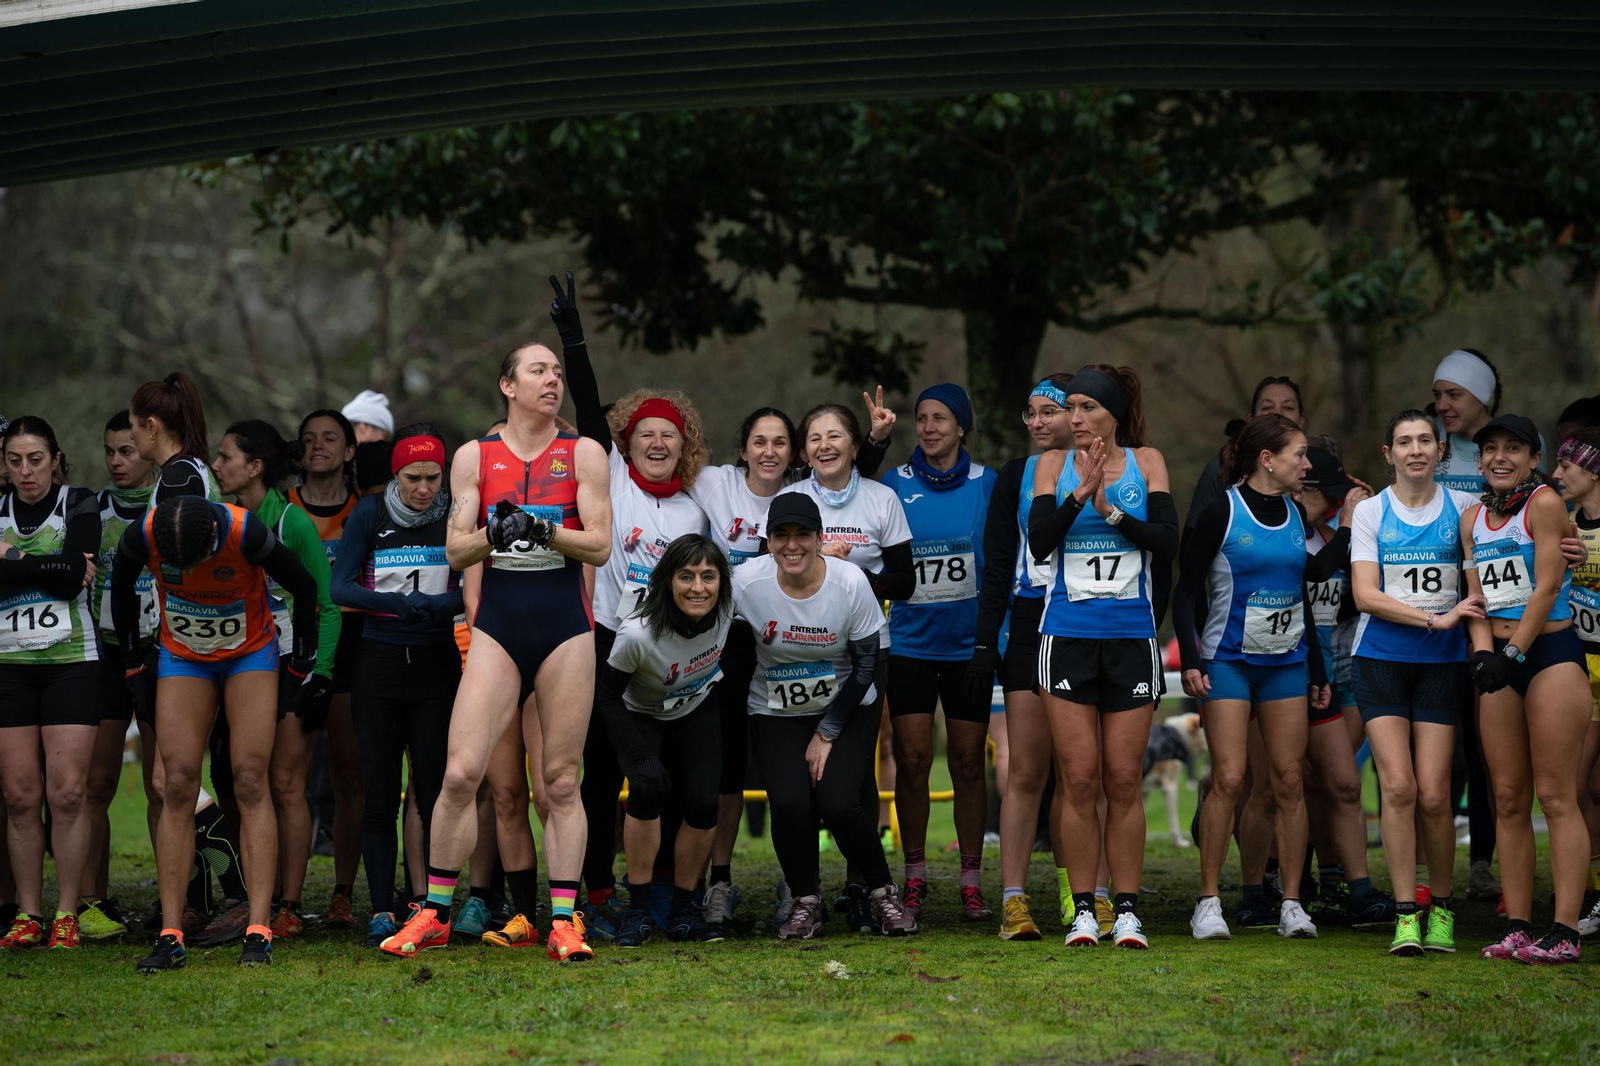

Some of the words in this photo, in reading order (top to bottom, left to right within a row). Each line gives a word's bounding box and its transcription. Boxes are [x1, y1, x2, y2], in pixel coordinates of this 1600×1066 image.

[539, 513, 561, 521] 2026
[911, 544, 949, 555] BADAVIA
[951, 542, 972, 551] 2026
[1066, 540, 1116, 551] RIBADAVIA
[1501, 544, 1520, 554] 2026
[375, 554, 426, 566] RIBADAVIA
[1384, 552, 1436, 562] RIBADAVIA
[1438, 551, 1457, 560] 2026
[40, 563, 71, 571] KIPSTA
[913, 557, 967, 585] 178
[1086, 555, 1122, 581] 17
[406, 569, 421, 592] 1
[1403, 567, 1442, 594] 18
[1482, 559, 1522, 590] 44
[1248, 595, 1294, 606] RIBADAVIA
[1309, 581, 1340, 606] 146
[165, 600, 219, 616] RIBADAVIA
[5, 604, 59, 632] 116
[1266, 609, 1292, 635] 19
[172, 616, 241, 638] 230
[790, 625, 829, 634] ENTRENA
[782, 631, 838, 642] RUNNING
[782, 639, 838, 648] entrenarunning.com
[690, 644, 719, 665] ENTRENA
[811, 664, 833, 675] 2026
[774, 679, 833, 709] 184
